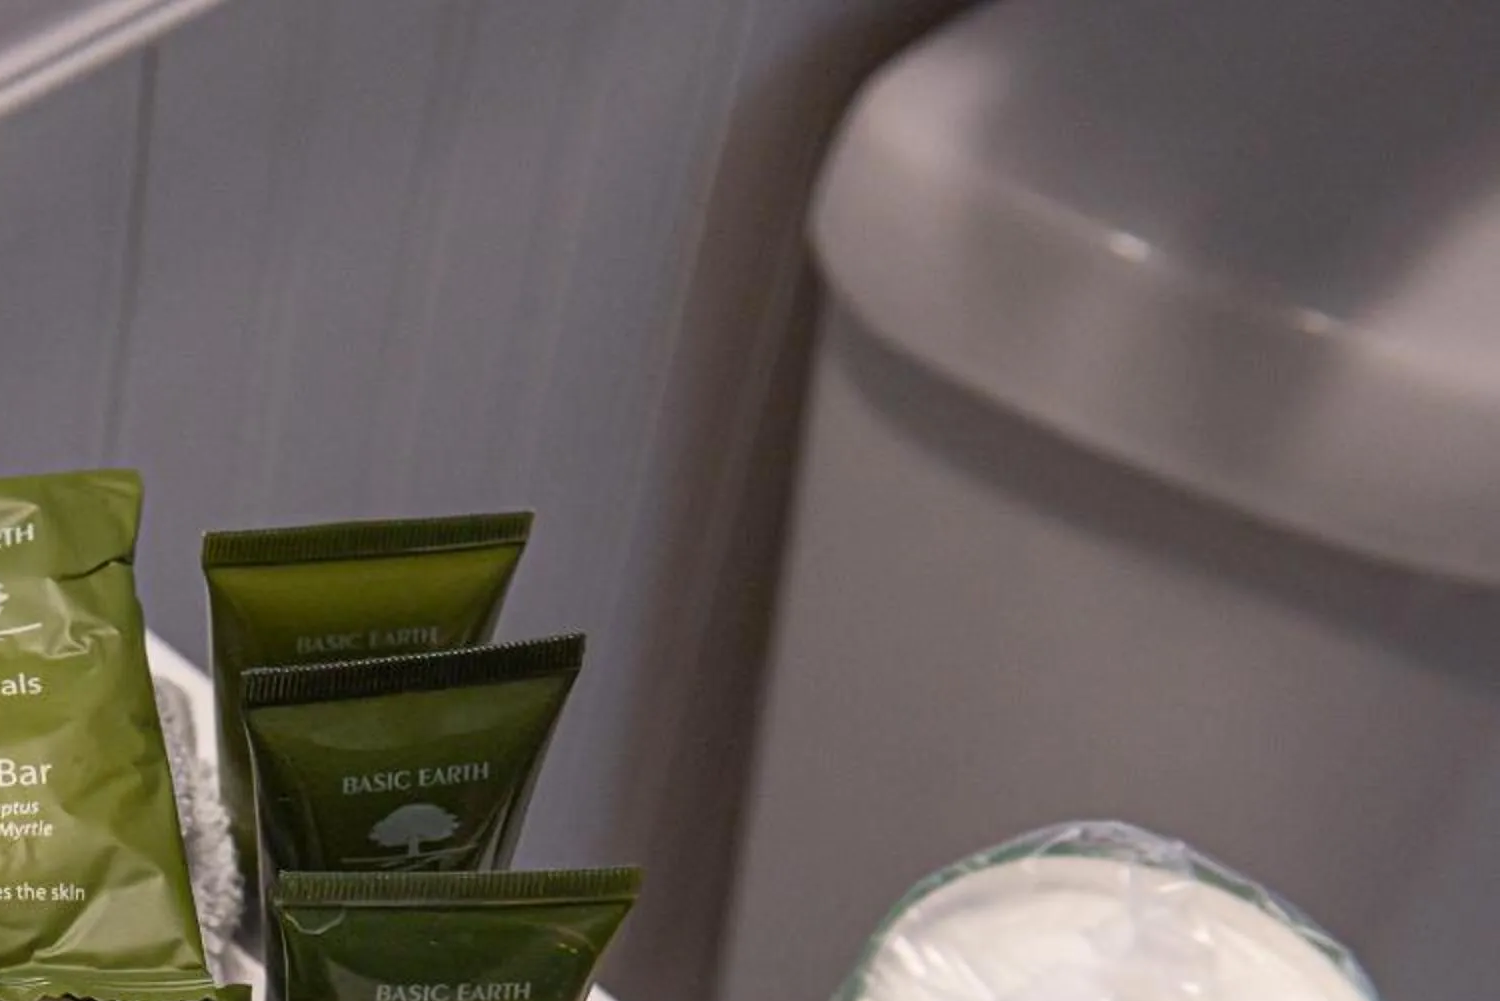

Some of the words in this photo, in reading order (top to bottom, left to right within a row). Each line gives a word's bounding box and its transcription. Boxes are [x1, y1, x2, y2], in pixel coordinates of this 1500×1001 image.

[297, 633, 364, 654] BASIC
[342, 769, 412, 795] BASIC
[418, 762, 490, 787] EARTH
[15, 884, 46, 901] the
[51, 884, 86, 901] skin
[457, 982, 532, 1001] EARTH
